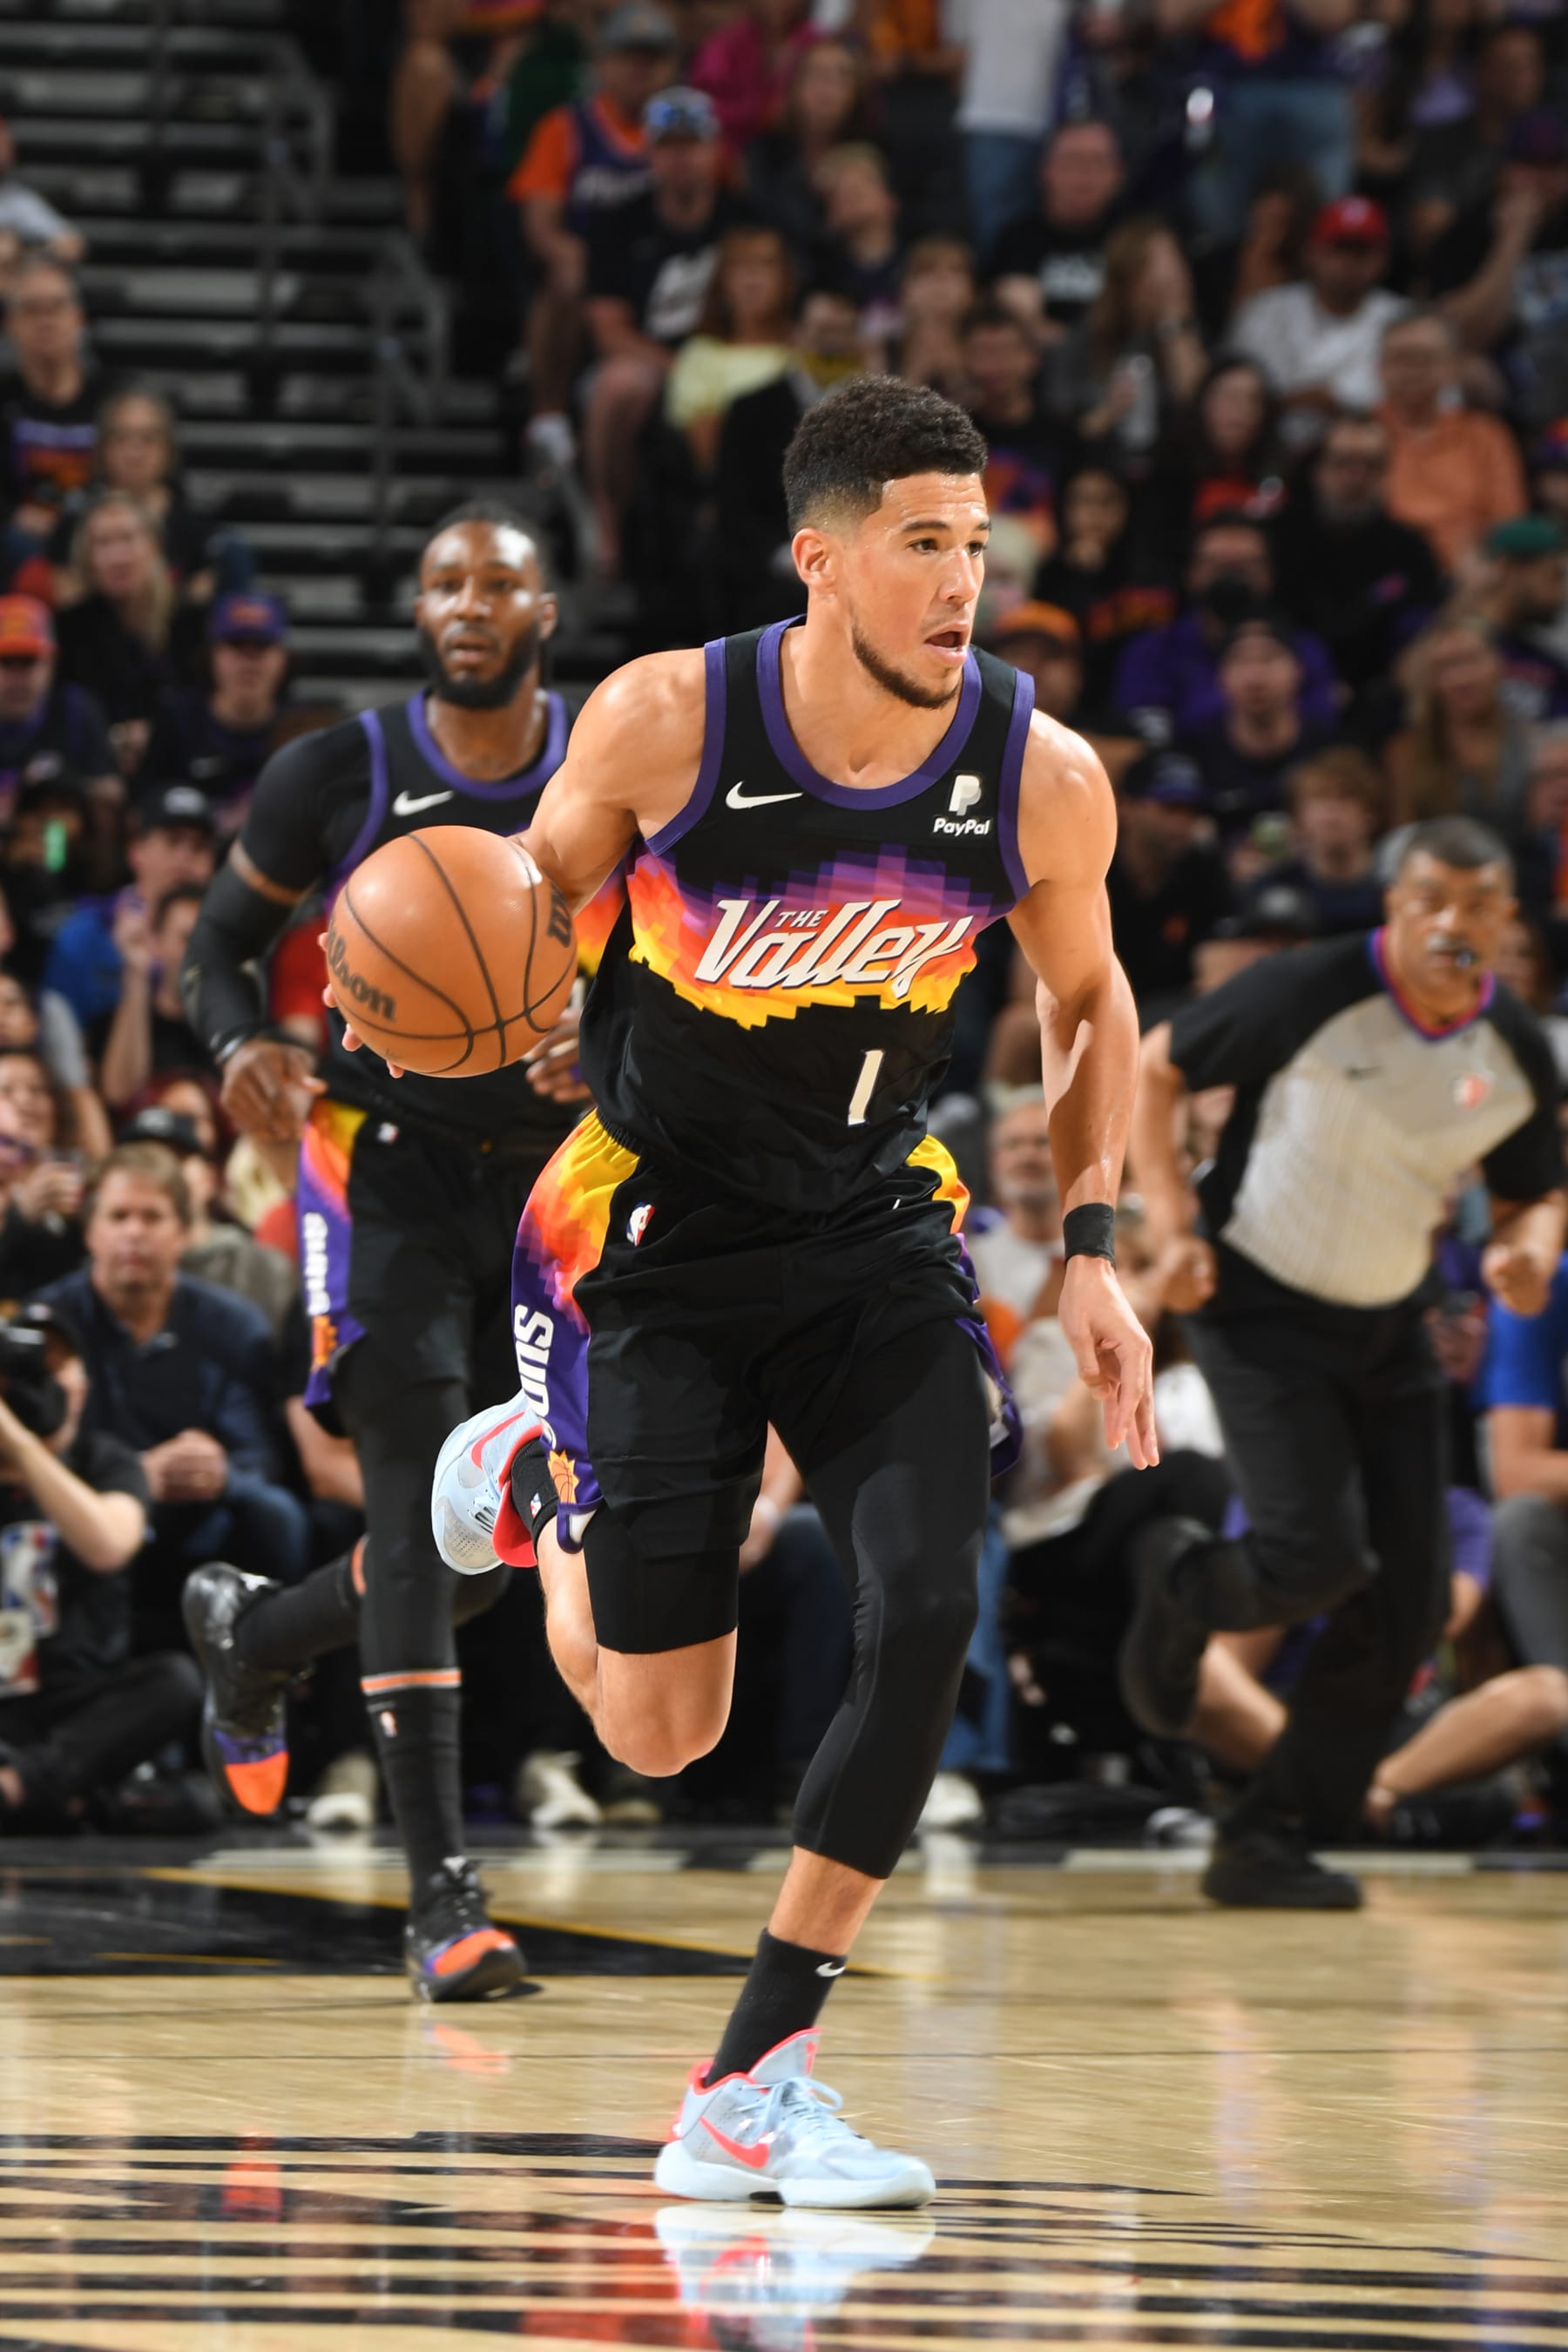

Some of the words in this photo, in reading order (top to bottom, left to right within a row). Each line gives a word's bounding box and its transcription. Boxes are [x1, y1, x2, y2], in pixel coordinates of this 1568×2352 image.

[933, 817, 990, 837] PayPal
[774, 909, 828, 929] THE
[693, 898, 974, 999] Valley
[848, 1050, 884, 1126] 1
